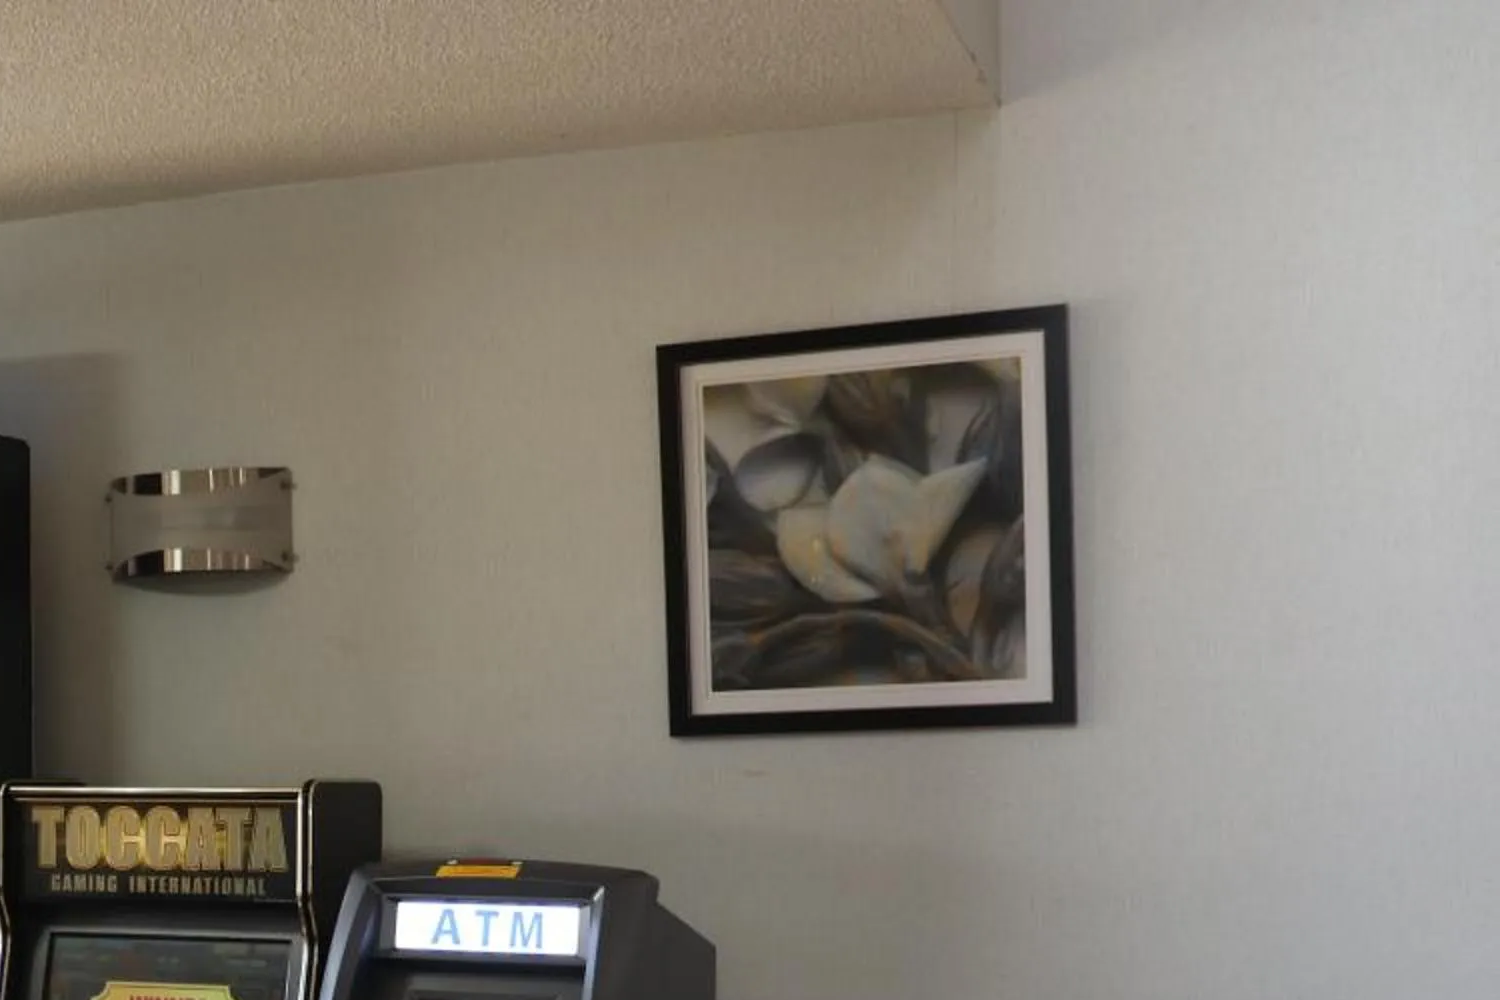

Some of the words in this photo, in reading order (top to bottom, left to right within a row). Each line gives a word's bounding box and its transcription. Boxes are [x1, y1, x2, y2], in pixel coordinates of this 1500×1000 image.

[31, 805, 289, 872] TOCCATA
[50, 872, 117, 894] GAMING
[129, 874, 266, 896] INTERNATIONAL
[430, 908, 544, 950] ATM
